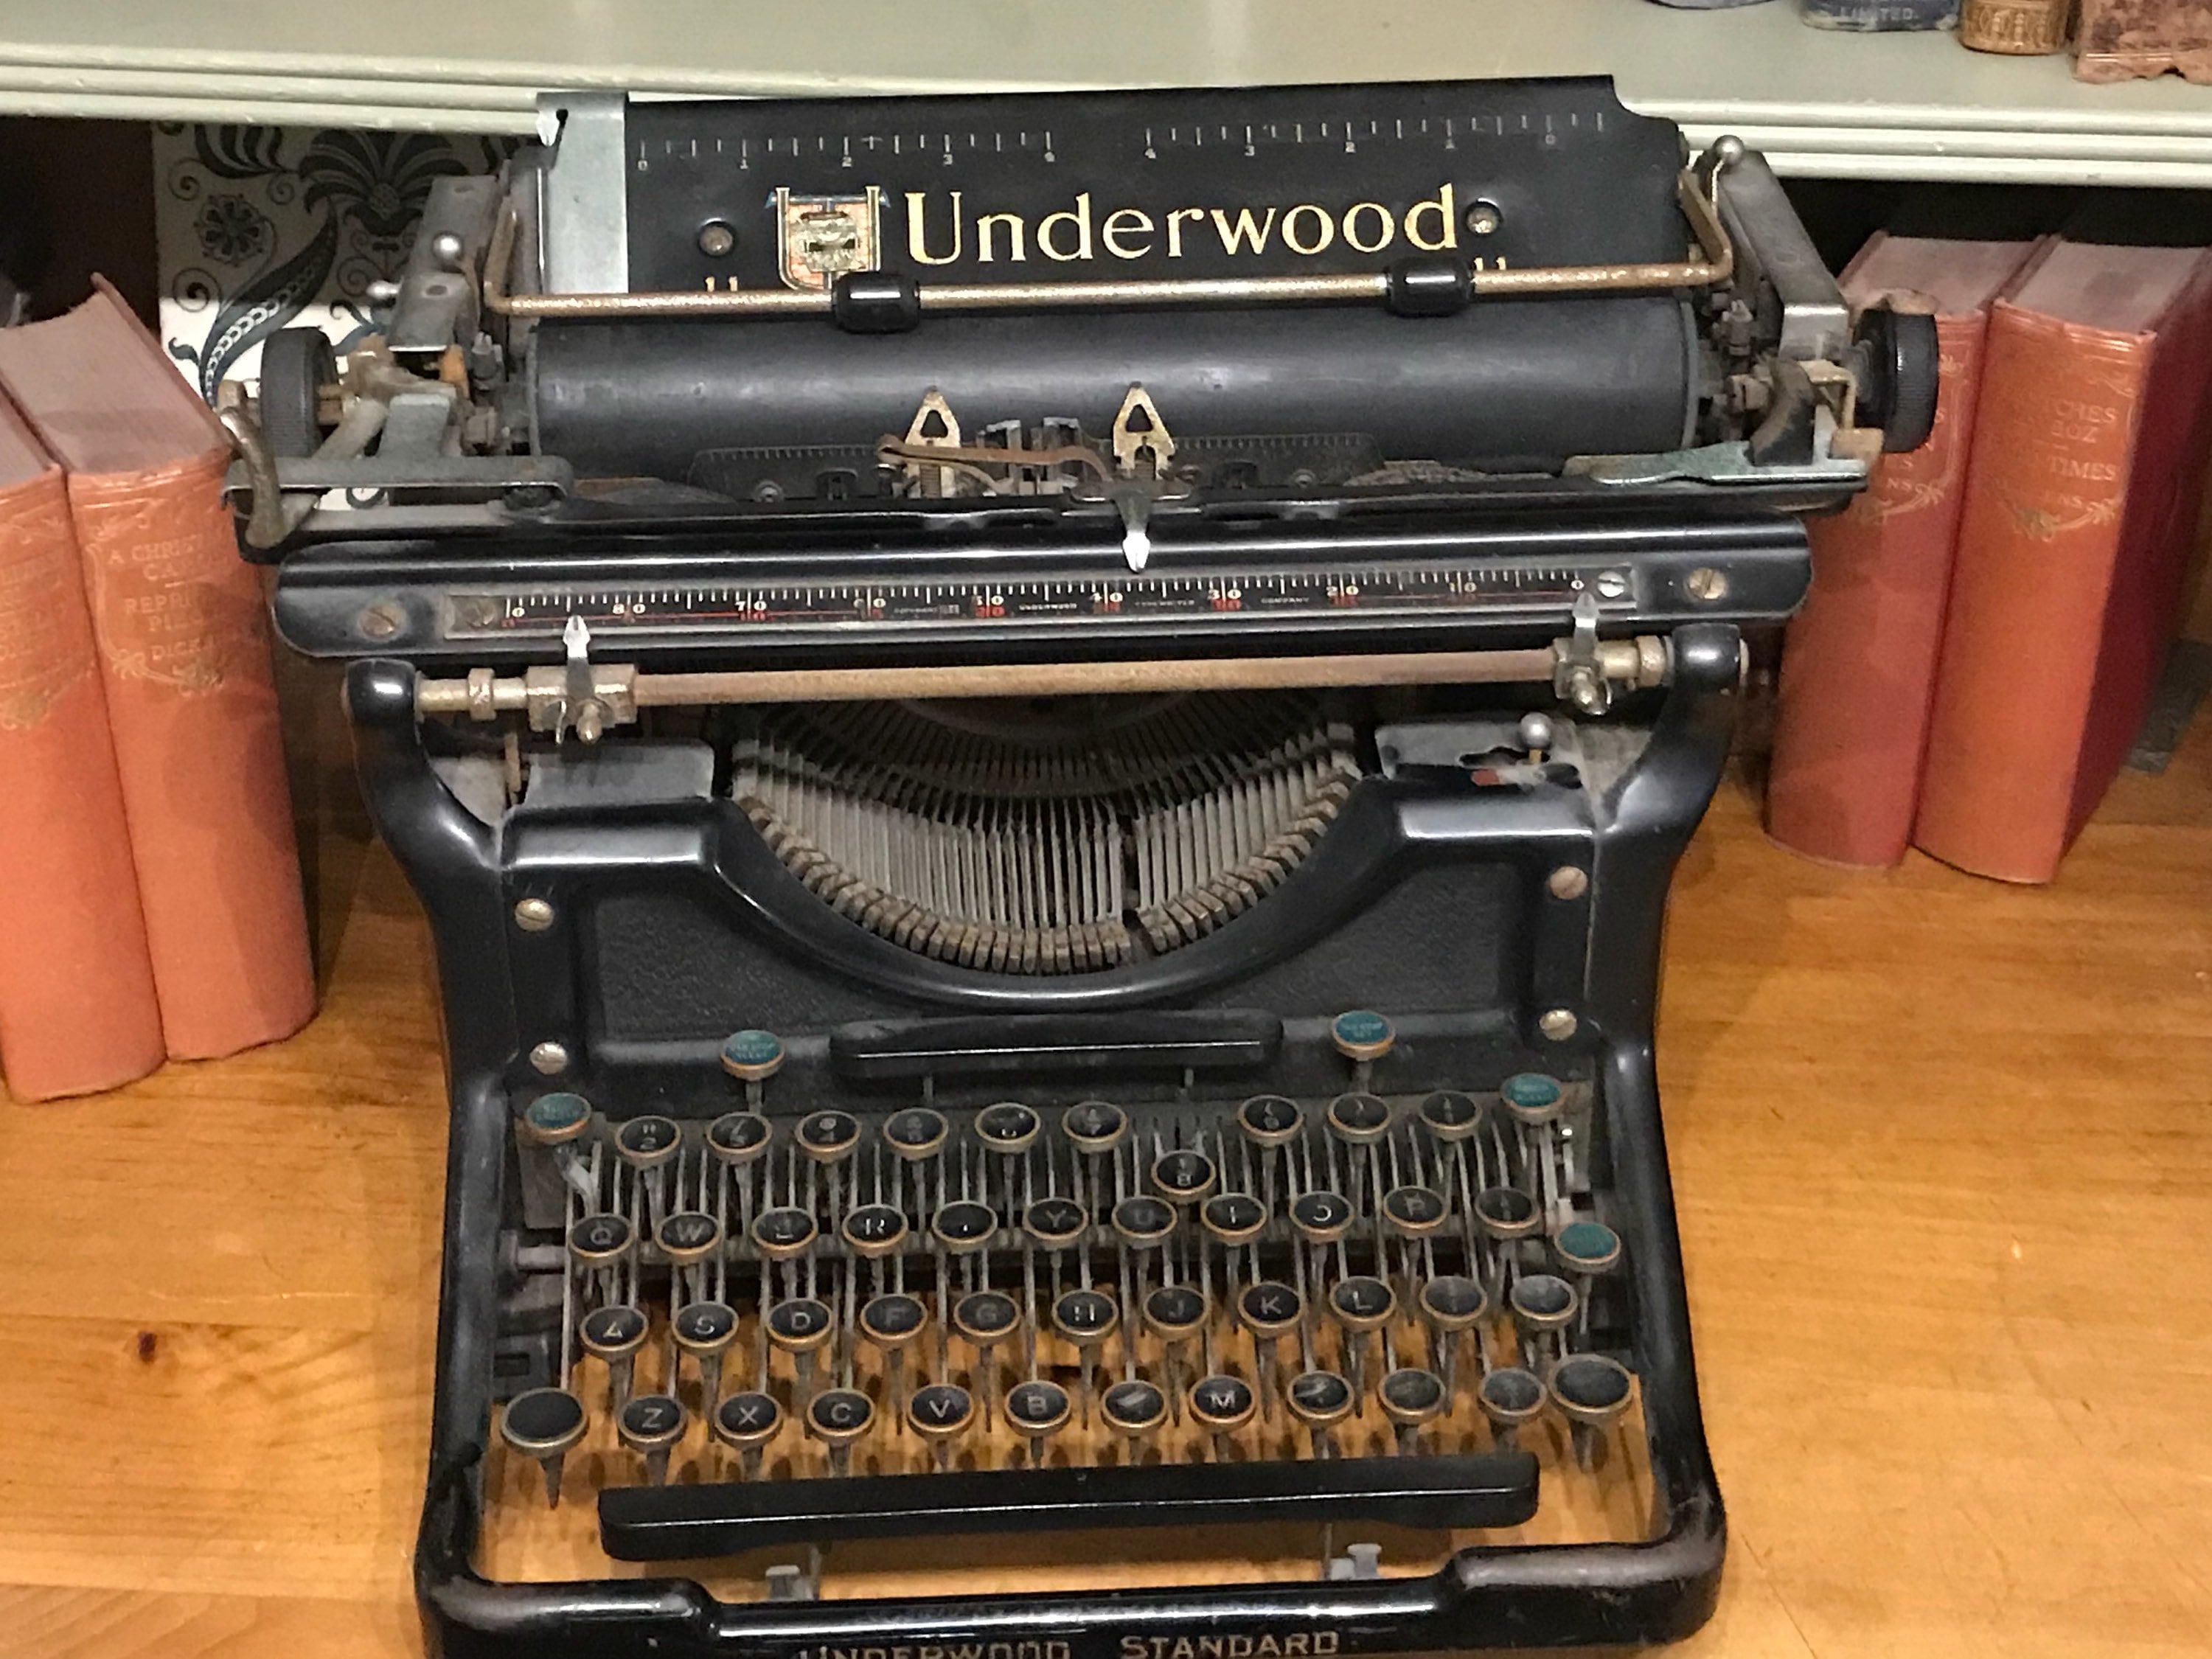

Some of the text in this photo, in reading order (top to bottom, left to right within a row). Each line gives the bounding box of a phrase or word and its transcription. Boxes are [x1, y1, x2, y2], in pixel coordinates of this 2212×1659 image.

[842, 156, 852, 167] 2
[943, 153, 953, 164] 3
[905, 183, 1458, 265] Underwood
[2051, 456, 2118, 481] TIMES
[108, 550, 124, 565] A
[1046, 1208, 1066, 1228] Y
[591, 1226, 612, 1244] Q
[675, 1222, 704, 1242] W
[1167, 1299, 1184, 1318] J
[1261, 1295, 1282, 1315] K
[1352, 1290, 1373, 1312] L
[790, 1311, 811, 1329] D
[886, 1308, 906, 1326] F
[976, 1304, 996, 1324] G
[694, 1315, 715, 1335] S
[928, 1399, 950, 1419] V
[1026, 1396, 1048, 1415] B
[1208, 1389, 1237, 1409] M
[641, 1407, 664, 1429] Z
[737, 1405, 759, 1425] X
[830, 1403, 852, 1423] C
[1119, 1630, 1340, 1659] STANDARD
